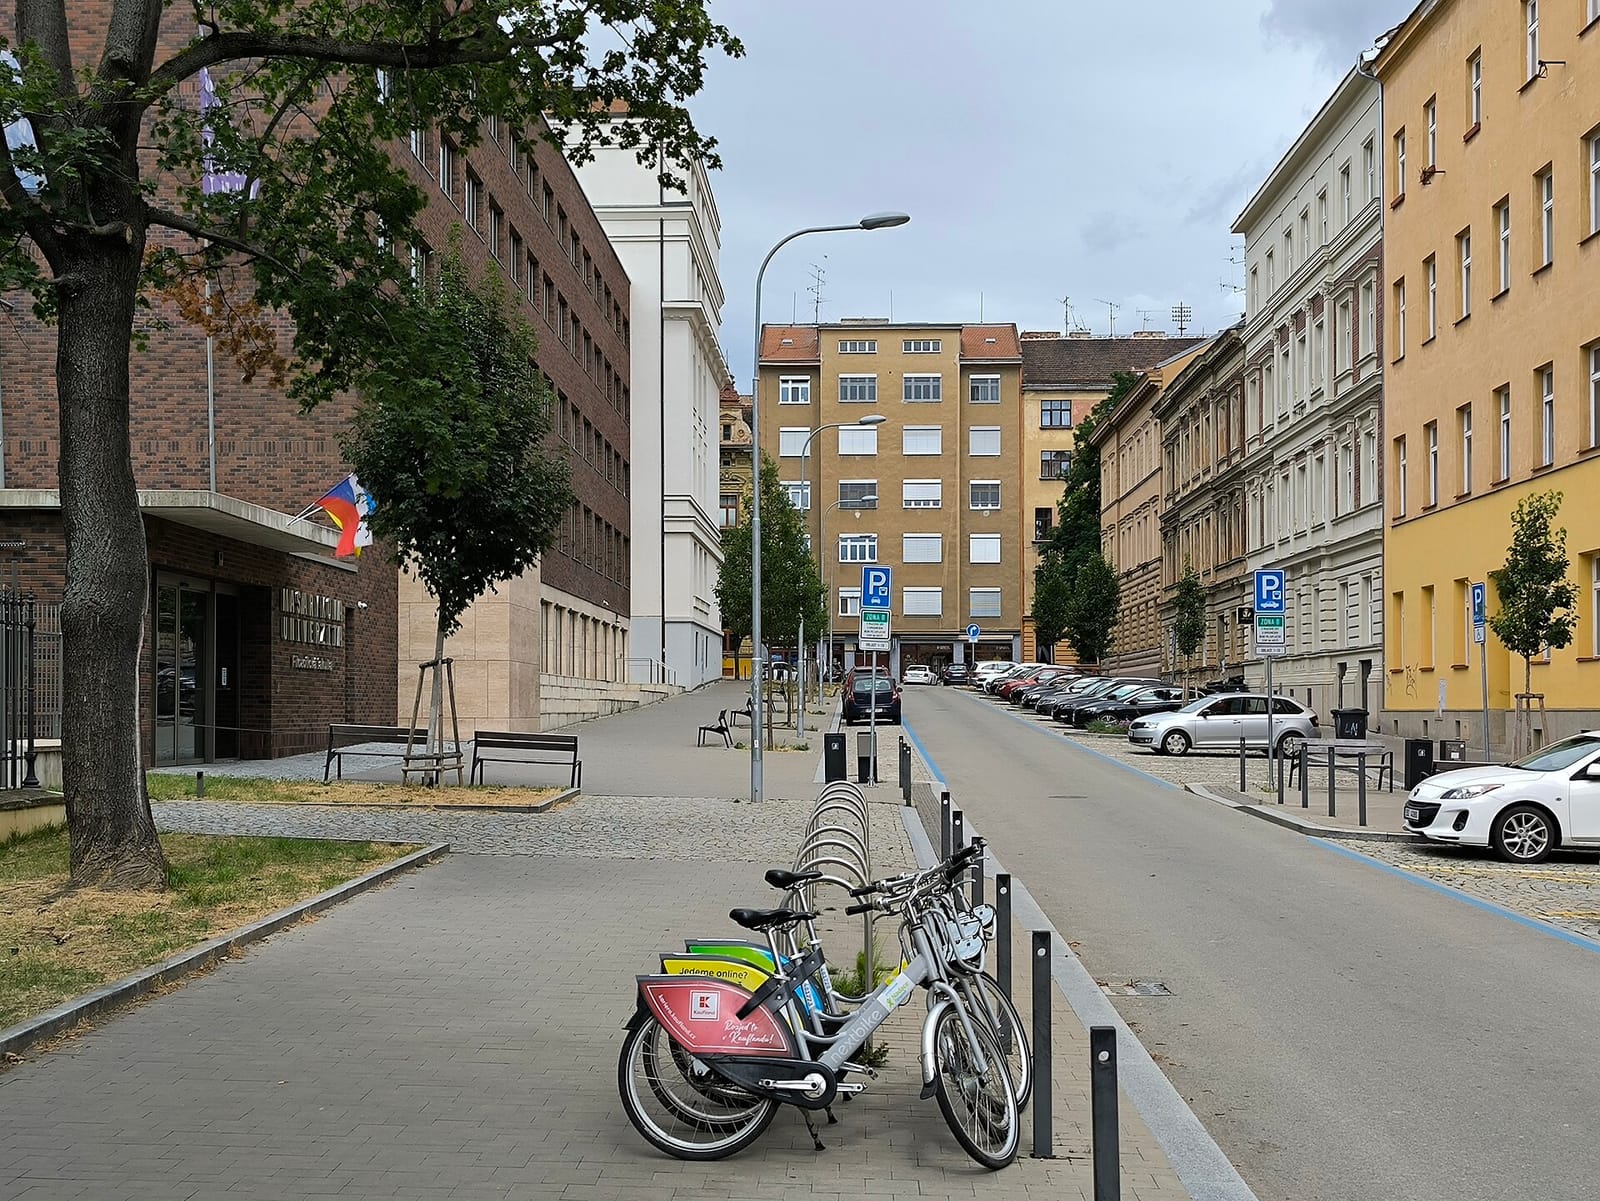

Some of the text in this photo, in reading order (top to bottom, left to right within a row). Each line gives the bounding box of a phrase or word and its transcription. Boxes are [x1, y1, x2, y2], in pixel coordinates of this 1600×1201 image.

[869, 571, 886, 595] P
[1262, 575, 1279, 599] P
[716, 970, 749, 979] online?
[830, 1009, 882, 1063] nextbike
